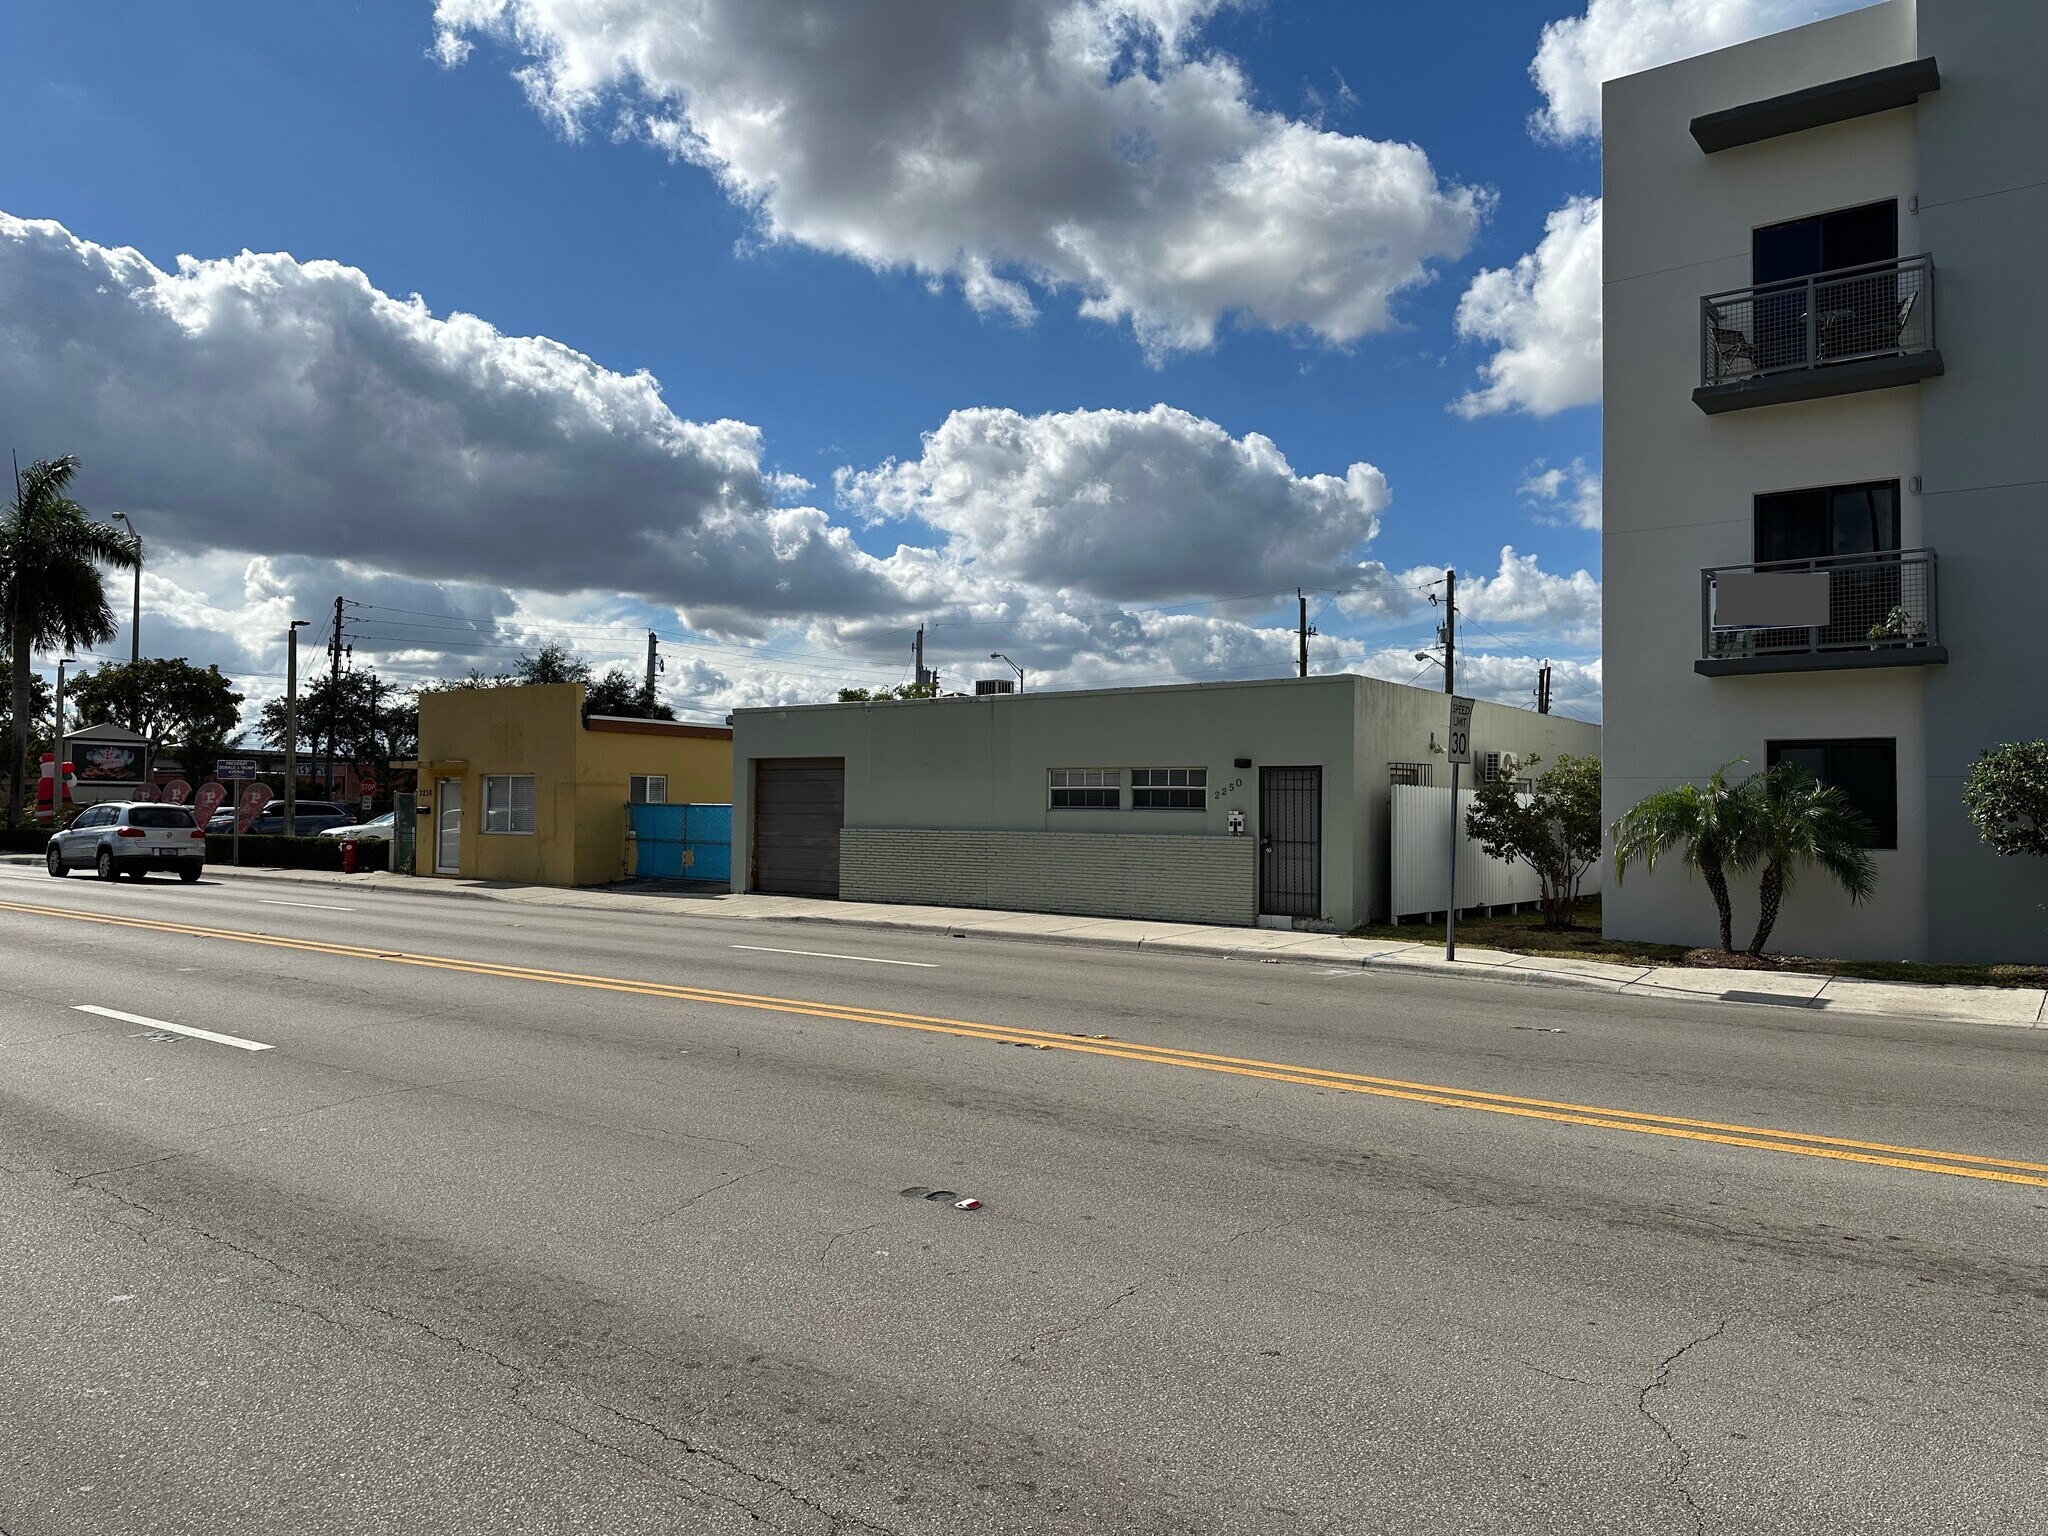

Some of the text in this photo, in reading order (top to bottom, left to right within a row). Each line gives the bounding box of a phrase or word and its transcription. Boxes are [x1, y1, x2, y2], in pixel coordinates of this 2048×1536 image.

[1452, 703, 1470, 716] SPEED
[1453, 716, 1467, 727] LIMIT
[1451, 731, 1467, 755] 30
[419, 789, 432, 797] 2230
[1214, 778, 1243, 799] 2250
